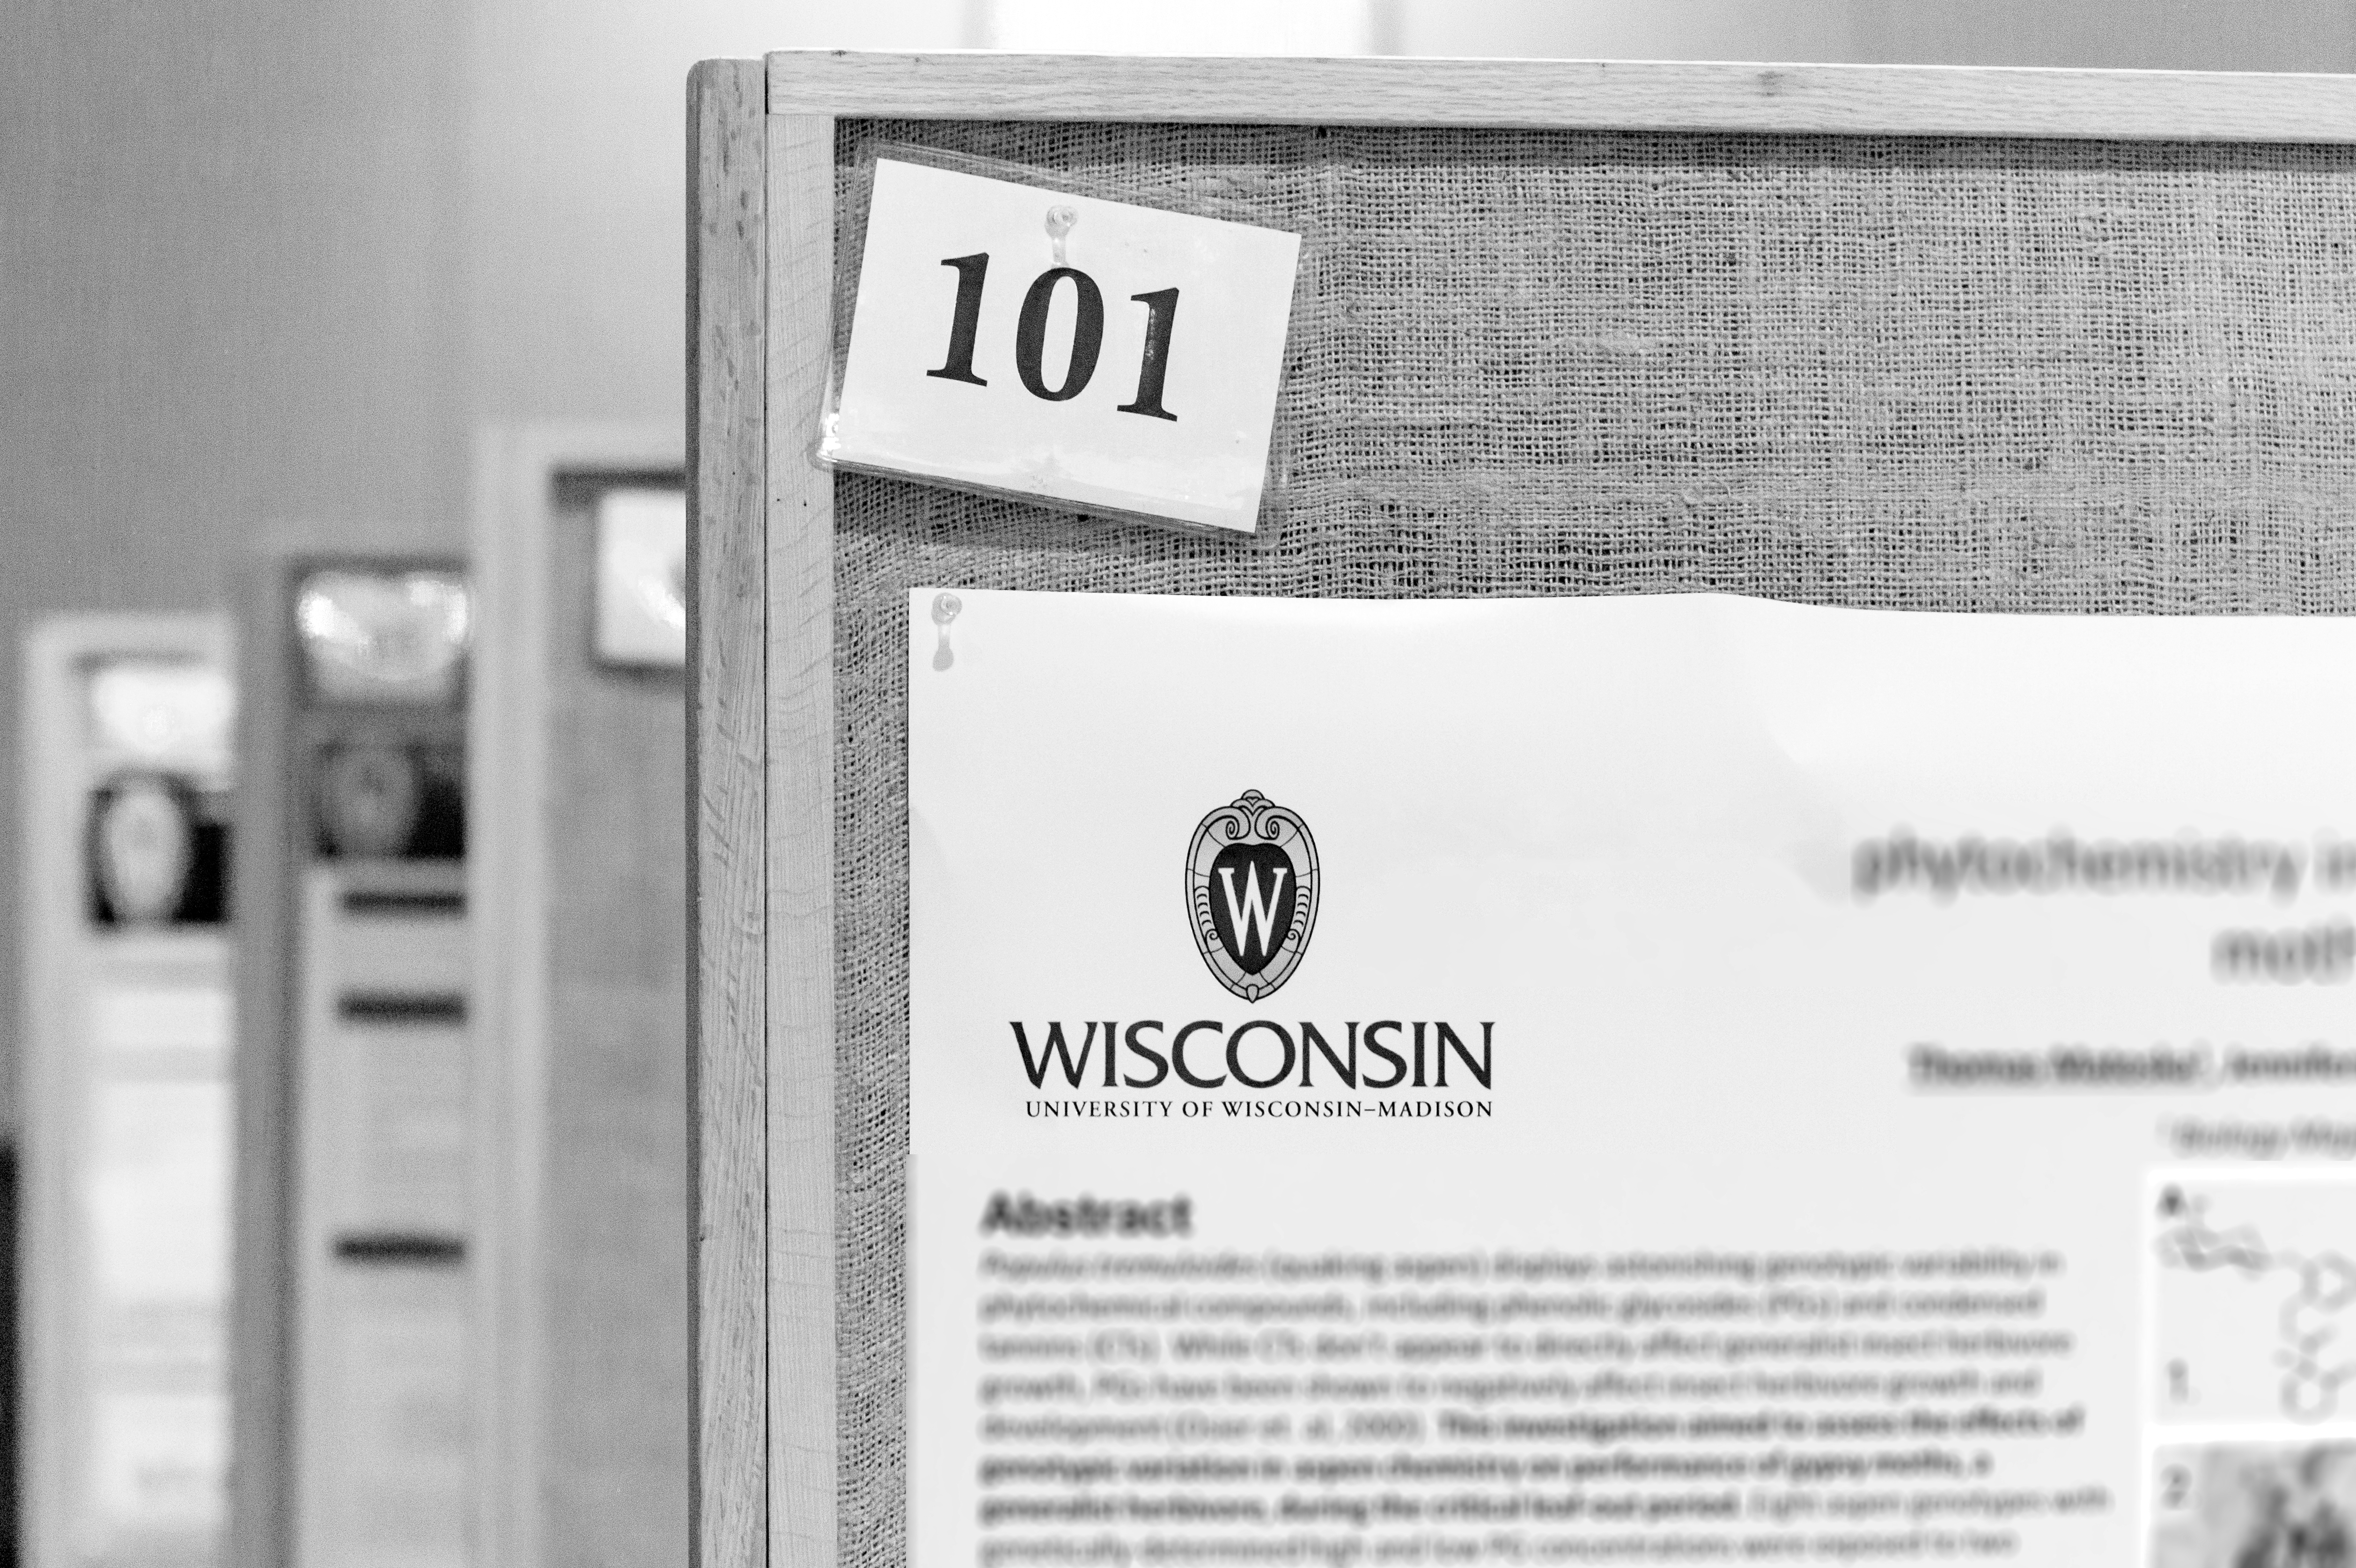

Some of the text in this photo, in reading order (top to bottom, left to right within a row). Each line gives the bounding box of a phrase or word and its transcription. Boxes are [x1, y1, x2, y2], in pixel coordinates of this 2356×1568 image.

[927, 252, 1179, 422] 101
[1855, 828, 2304, 902] phytochemistry
[1218, 860, 1288, 958] W
[1009, 1020, 1495, 1090] WISCONSIN
[1025, 1100, 1173, 1118] UNIVERSITY
[1182, 1100, 1214, 1118] OF
[977, 1192, 1196, 1238] Abstract
